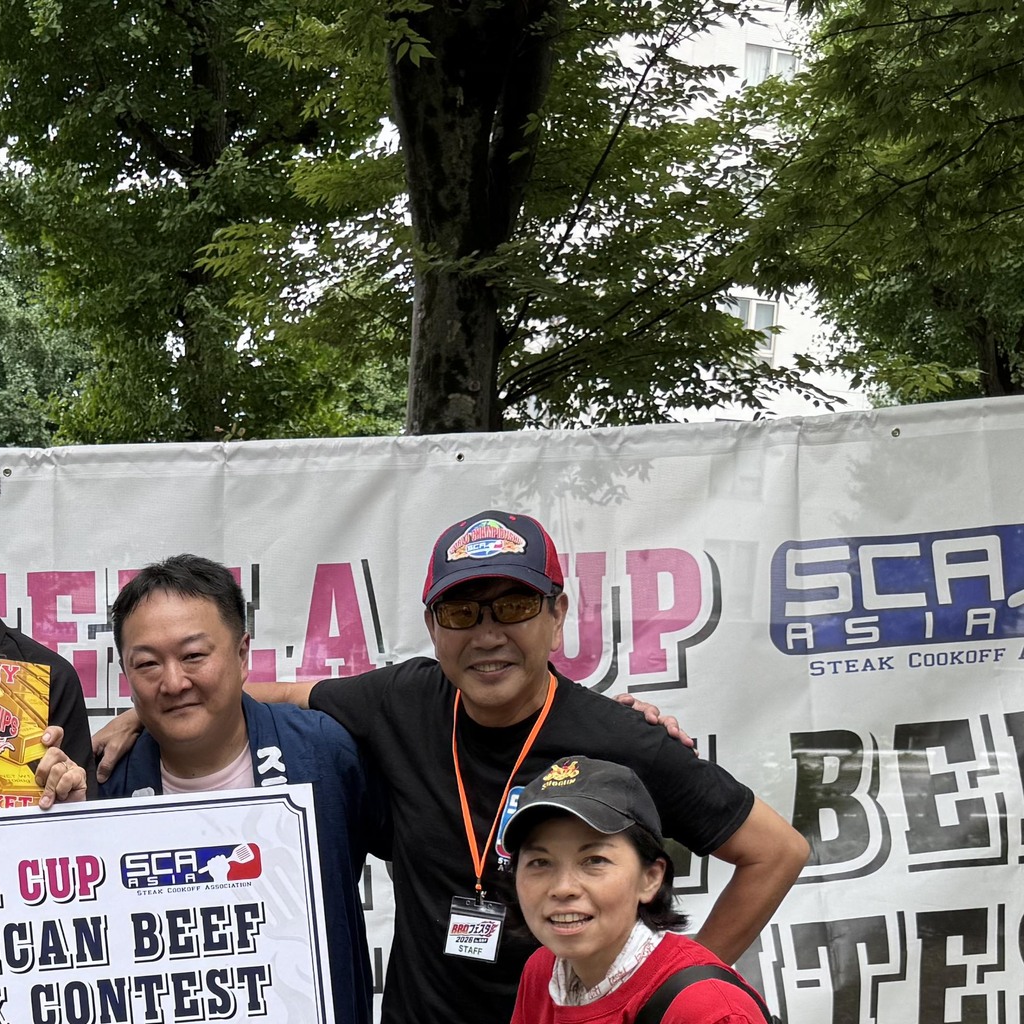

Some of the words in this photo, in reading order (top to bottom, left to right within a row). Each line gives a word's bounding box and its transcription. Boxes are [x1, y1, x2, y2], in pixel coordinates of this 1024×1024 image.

[784, 534, 1006, 617] SCA
[548, 547, 723, 695] UP
[785, 607, 997, 650] ASIA
[809, 656, 895, 676] STEAK
[908, 648, 1007, 668] COOKOFF
[789, 710, 1024, 884] BE
[17, 854, 107, 905] CUP
[125, 850, 198, 878] SCA
[128, 873, 196, 888] ASIA
[167, 885, 201, 893] COOKOFF
[205, 881, 252, 891] ASSOCIATION
[130, 901, 266, 963] BEEF
[458, 945, 483, 955] STAFF
